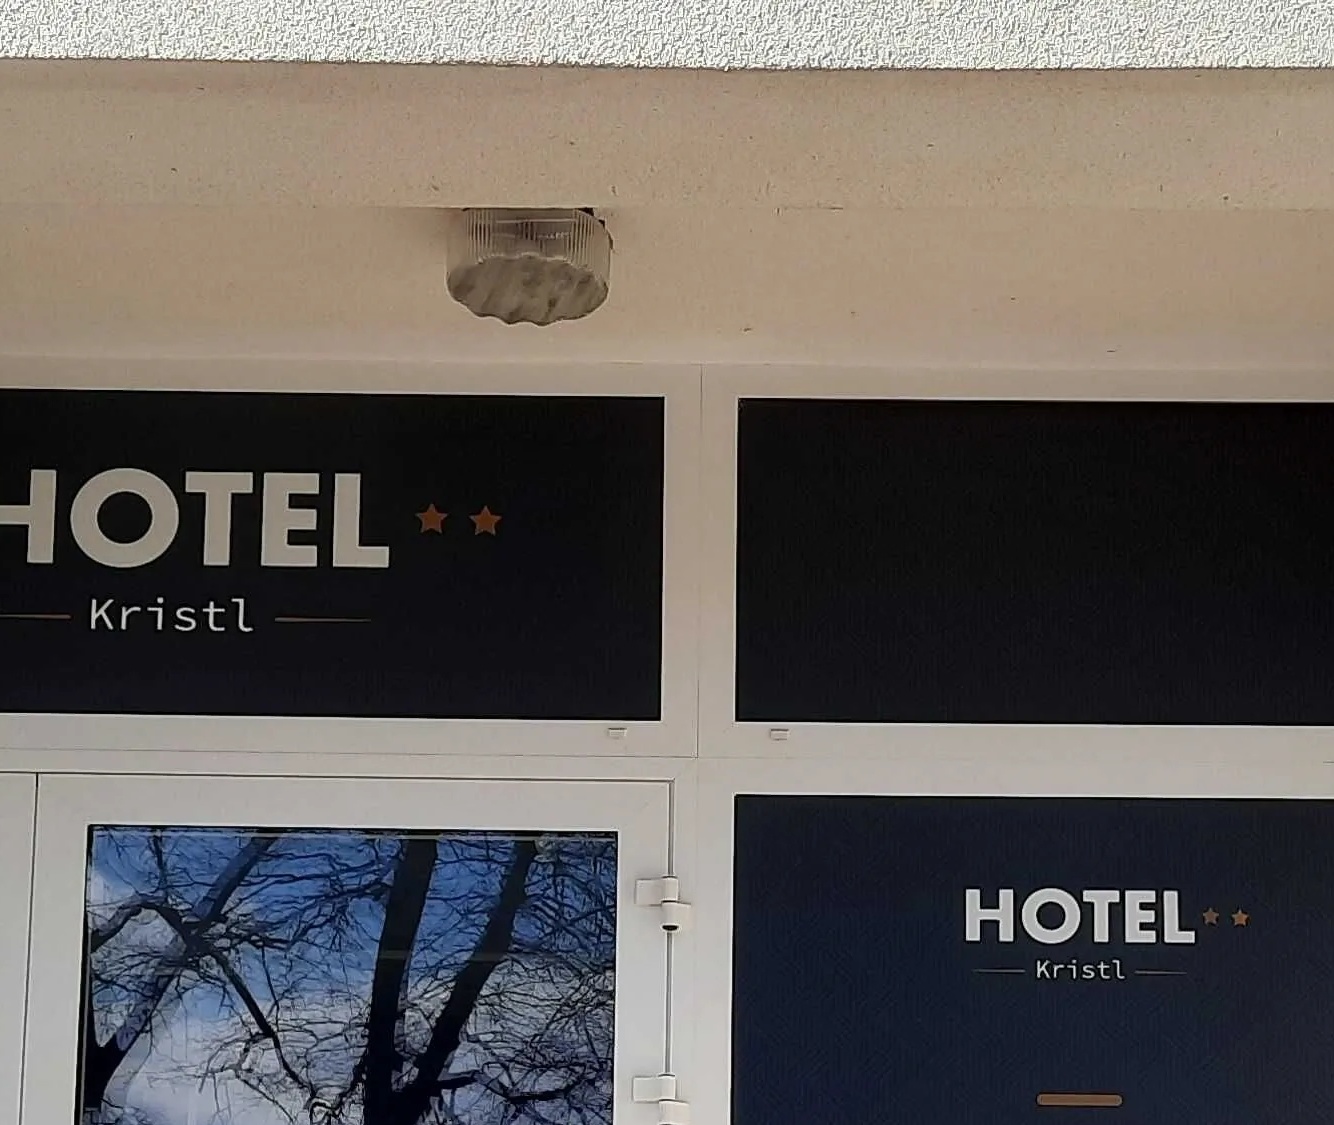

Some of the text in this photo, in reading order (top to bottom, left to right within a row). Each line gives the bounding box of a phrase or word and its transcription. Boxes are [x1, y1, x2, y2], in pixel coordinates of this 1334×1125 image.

[90, 597, 254, 633] Kristl
[965, 887, 1196, 944] HOTEL
[1036, 959, 1125, 980] Kristl
